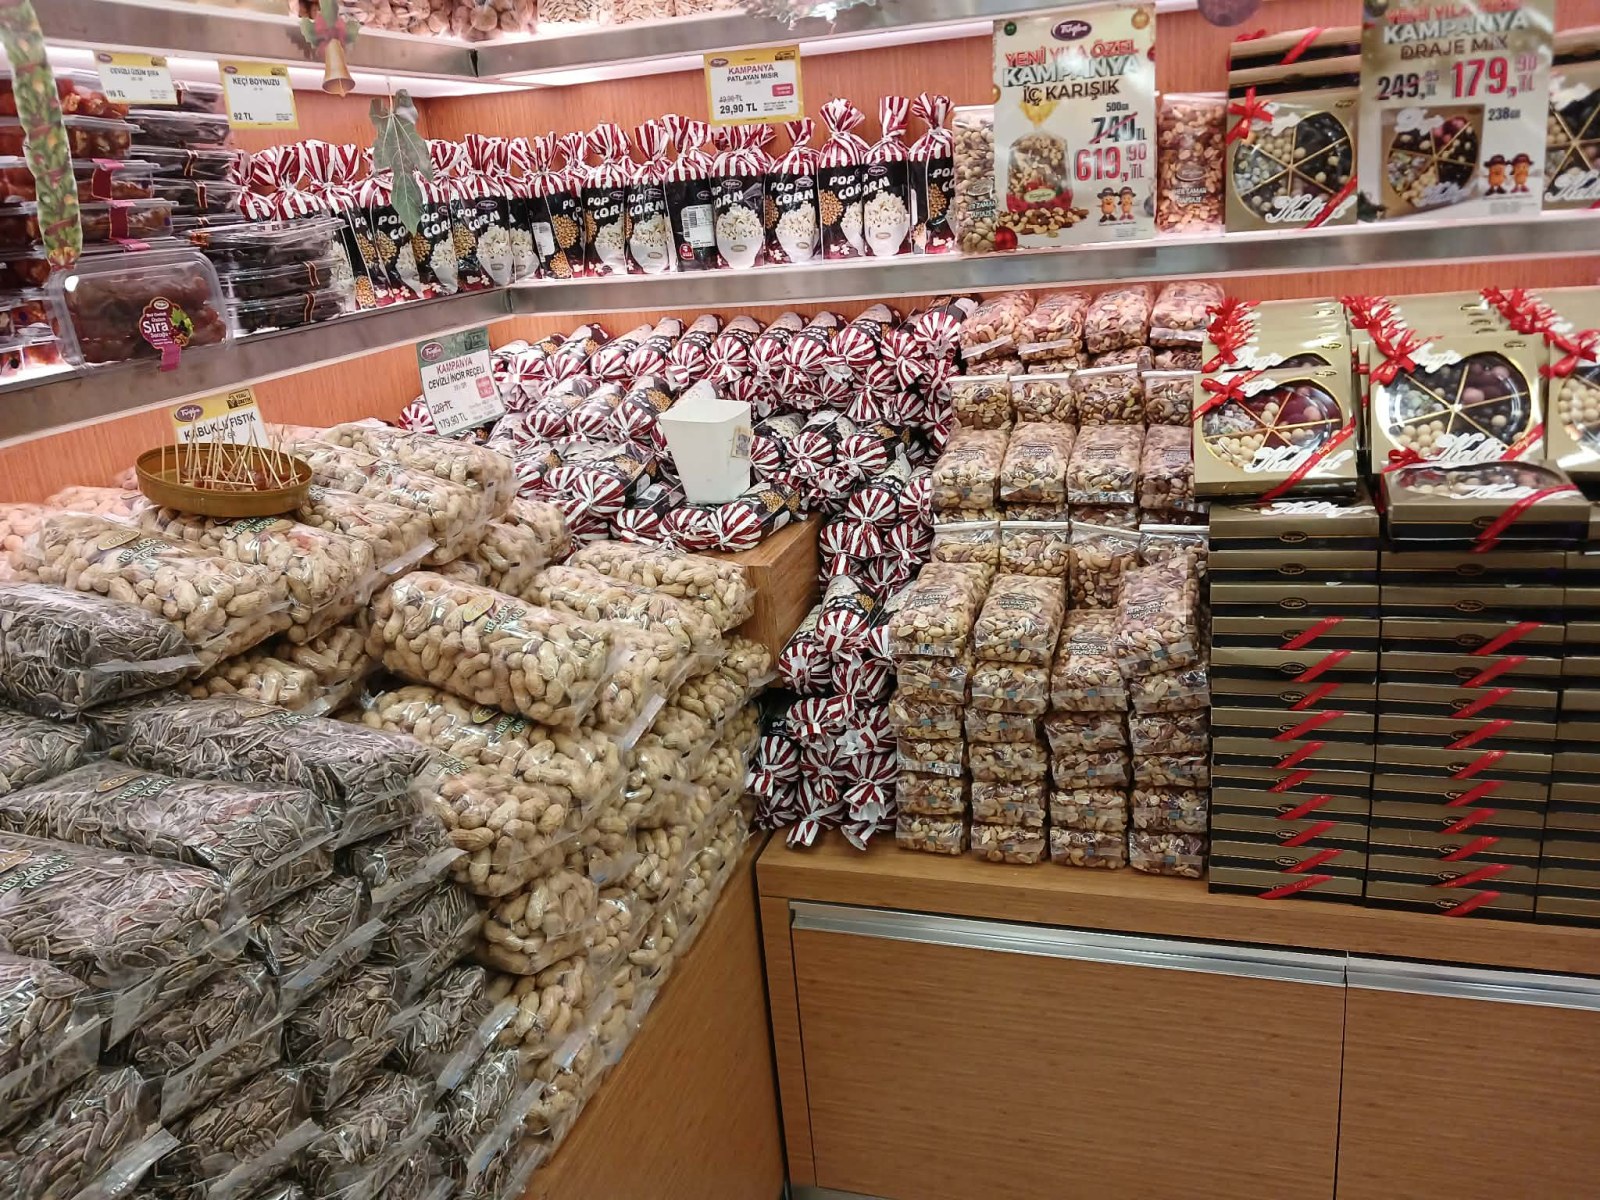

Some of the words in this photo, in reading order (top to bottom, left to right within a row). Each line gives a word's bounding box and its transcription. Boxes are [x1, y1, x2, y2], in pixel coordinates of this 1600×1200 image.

[1384, 10, 1529, 44] KAMPANYA
[1005, 48, 1047, 67] YENİ
[1090, 39, 1138, 58] ÖZEL
[1401, 38, 1465, 60] DRAJE
[727, 73, 760, 82] PATLAYAN
[728, 64, 774, 75] KAMPANYA
[1003, 54, 1140, 87] KAMPANYA
[232, 78, 249, 87] KEÇİ
[249, 78, 280, 86] BOYNUZU
[117, 90, 126, 98] TL
[1023, 85, 1043, 106] İÇ
[1046, 79, 1120, 101] KARIŞIK
[234, 112, 243, 121] 92
[243, 112, 253, 121] TL
[720, 104, 744, 115] 29,90
[746, 103, 758, 112] TL
[1092, 114, 1137, 144] 740
[1126, 143, 1148, 161] 90
[771, 182, 794, 192] POP
[829, 175, 856, 186] POP
[587, 196, 610, 206] POP
[776, 189, 814, 206] CORN
[457, 208, 478, 218] POP
[629, 200, 665, 217] CORN
[468, 211, 501, 231] CORN
[436, 357, 473, 375] KAMPANYA
[428, 375, 450, 390] CEVİZLİ
[450, 371, 466, 383] İNCİR
[465, 365, 485, 379] REÇELİ
[230, 411, 256, 428] FISTIK
[460, 412, 469, 422] TL
